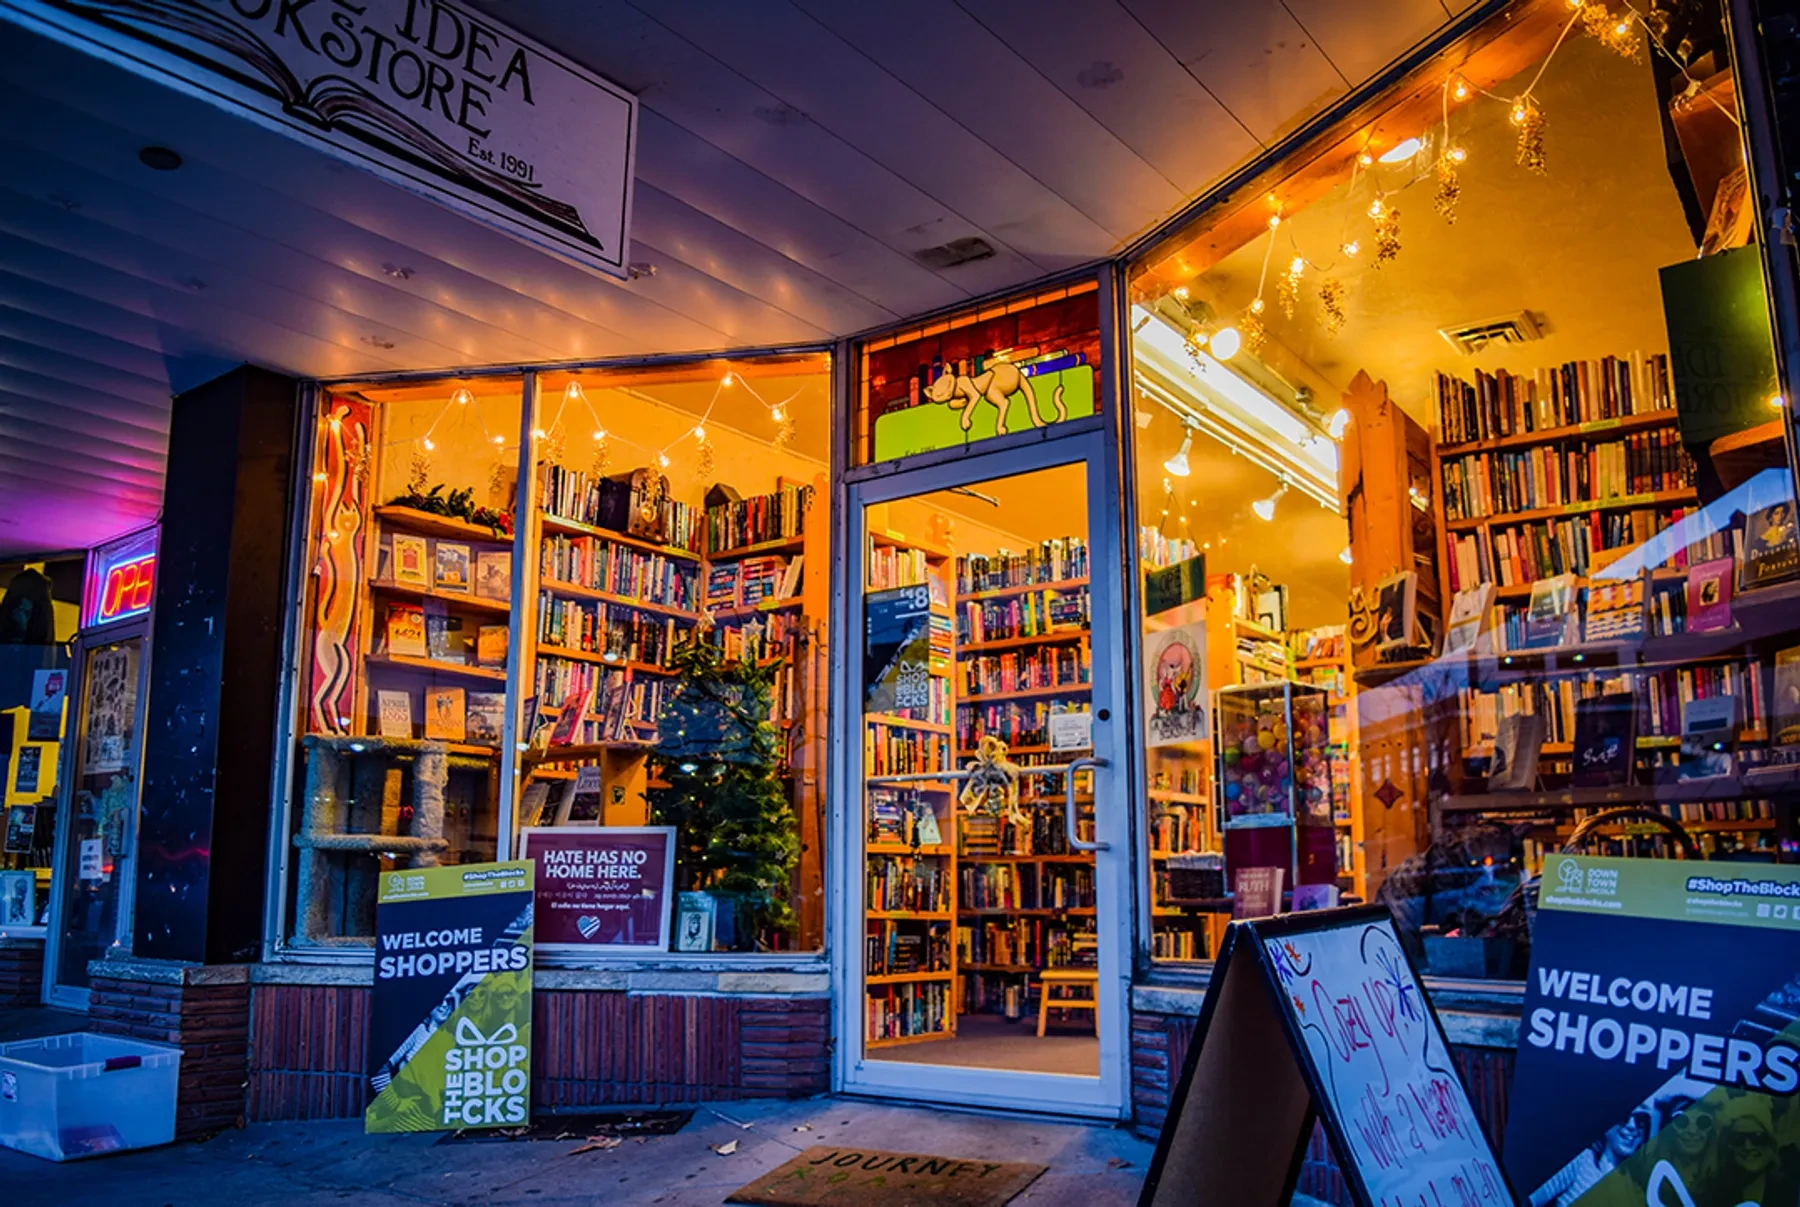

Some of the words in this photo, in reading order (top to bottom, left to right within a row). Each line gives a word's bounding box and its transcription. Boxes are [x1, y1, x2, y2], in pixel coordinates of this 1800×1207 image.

[394, 0, 535, 107] IDEA
[467, 136, 497, 166] Est.
[499, 151, 536, 182] 1991
[103, 558, 153, 616] OPE
[896, 672, 928, 685] SHOP
[543, 850, 583, 864] HATE
[586, 850, 619, 864] HAS
[621, 850, 648, 865] NO
[545, 864, 594, 879] HOME
[597, 864, 642, 879] HERE.
[1238, 880, 1269, 893] RUTH
[1587, 868, 1618, 879] DOWN
[1587, 879, 1617, 888] TOWN
[382, 927, 483, 951] WELCOME
[379, 946, 528, 980] SHOPPERS
[1538, 967, 1713, 1020] WELCOME
[444, 1045, 528, 1072] SHOP
[1527, 1008, 1799, 1093] SHOPPERS
[443, 1073, 464, 1125] THE
[463, 1068, 527, 1098] BLO
[461, 1095, 527, 1126] CKS
